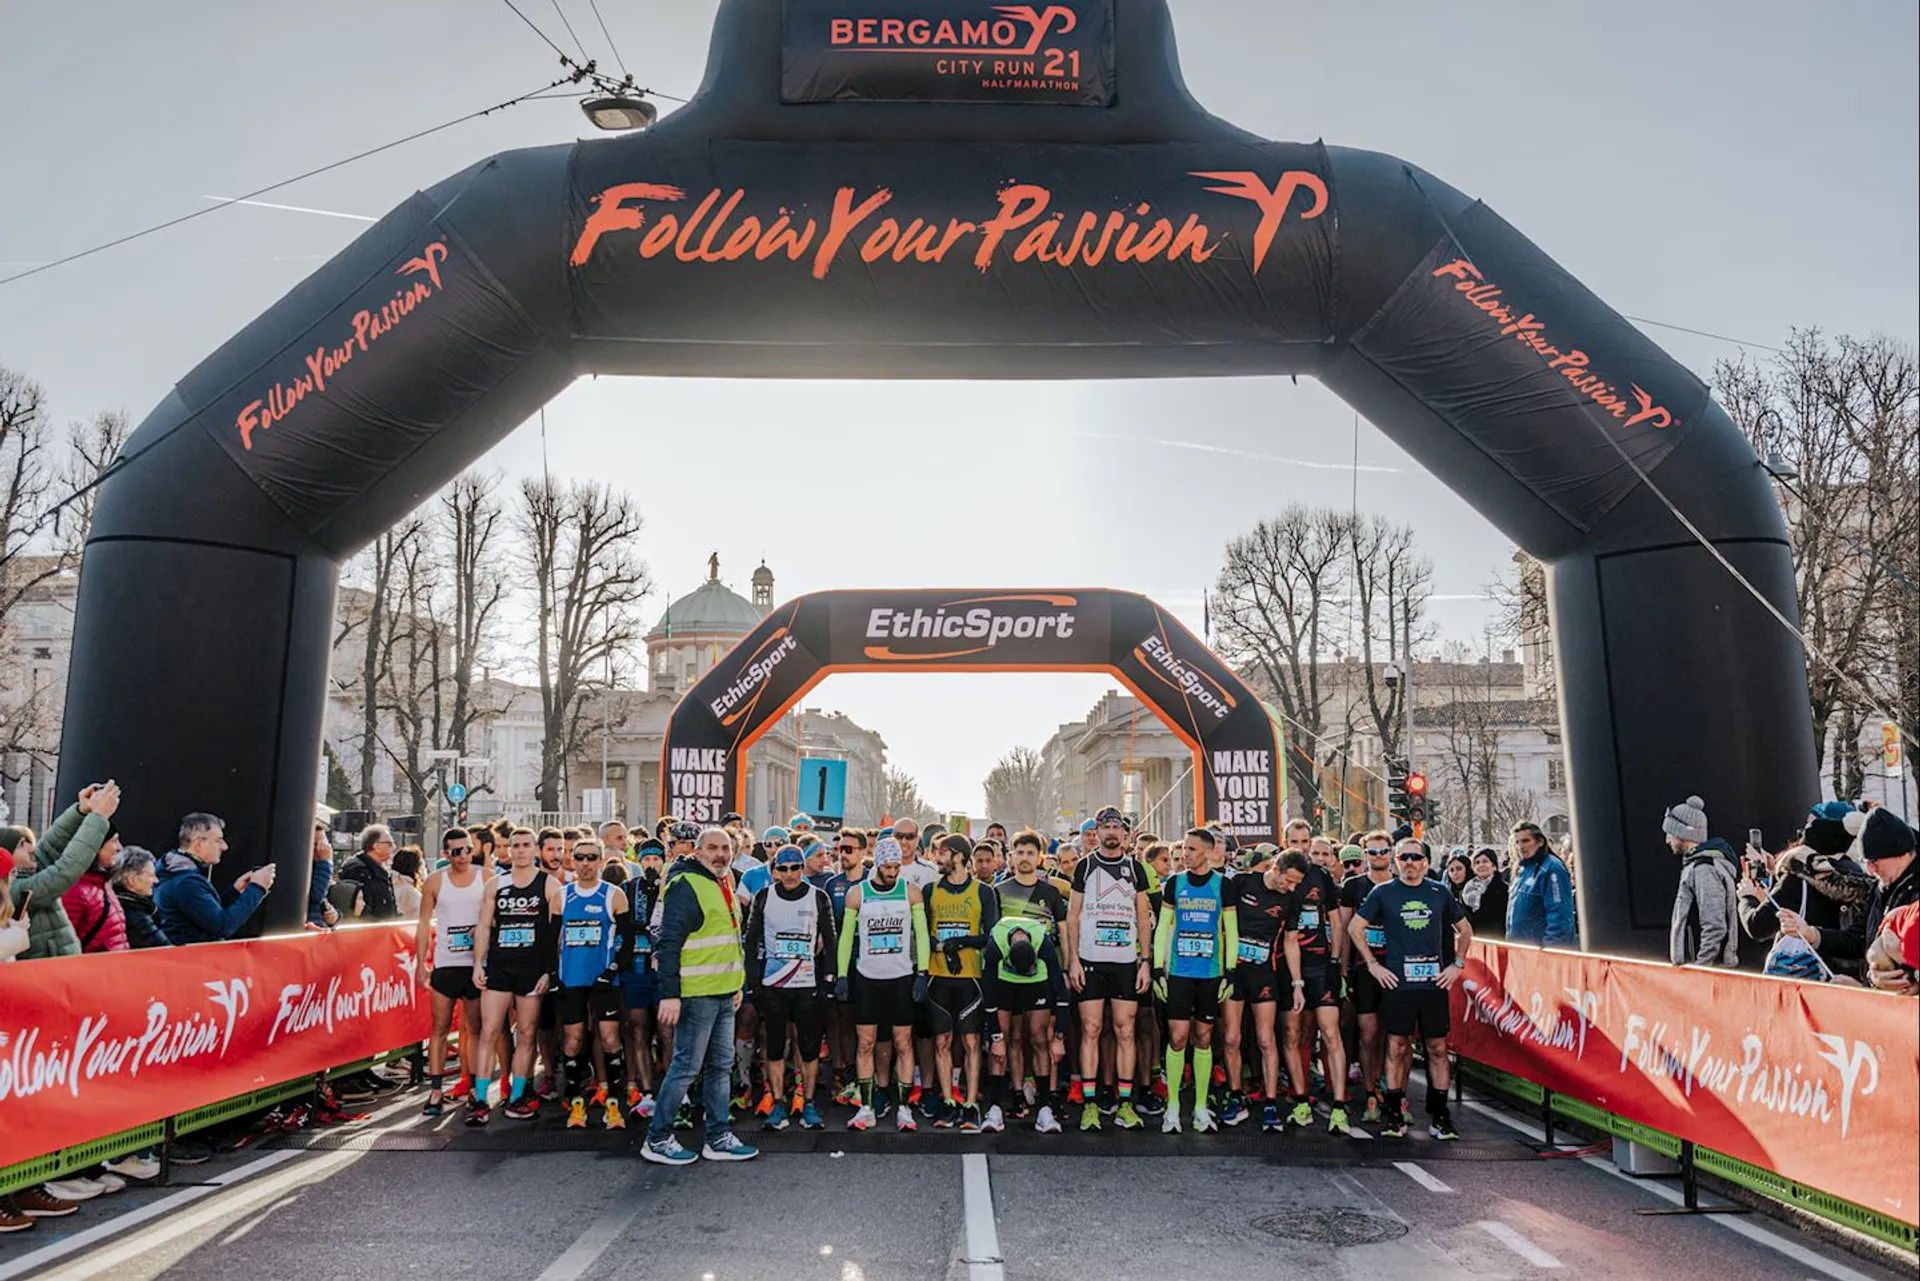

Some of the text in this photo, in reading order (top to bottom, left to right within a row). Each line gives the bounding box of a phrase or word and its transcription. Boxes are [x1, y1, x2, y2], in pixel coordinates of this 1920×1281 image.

[831, 19, 1016, 46] BERGAMO
[936, 50, 1080, 77] CITY RUN 21
[982, 79, 1079, 91] HALFMARATHON
[865, 608, 1075, 646] EthicSport
[710, 633, 798, 720] EthicSport
[1141, 634, 1231, 720] EthicSport
[670, 748, 727, 772] MAKE
[1213, 750, 1269, 774] MAKE
[671, 773, 725, 798] YOUR
[818, 766, 827, 812] 1
[1215, 776, 1269, 800] YOUR
[671, 798, 722, 822] BEST
[1218, 800, 1269, 824] BEST
[1224, 825, 1272, 836] RFORMANCE
[510, 930, 523, 941] 33
[786, 941, 800, 952] 63
[1107, 930, 1120, 940] 25
[1190, 941, 1202, 951] 19
[1244, 946, 1257, 957] 13
[1414, 965, 1433, 976] 572
